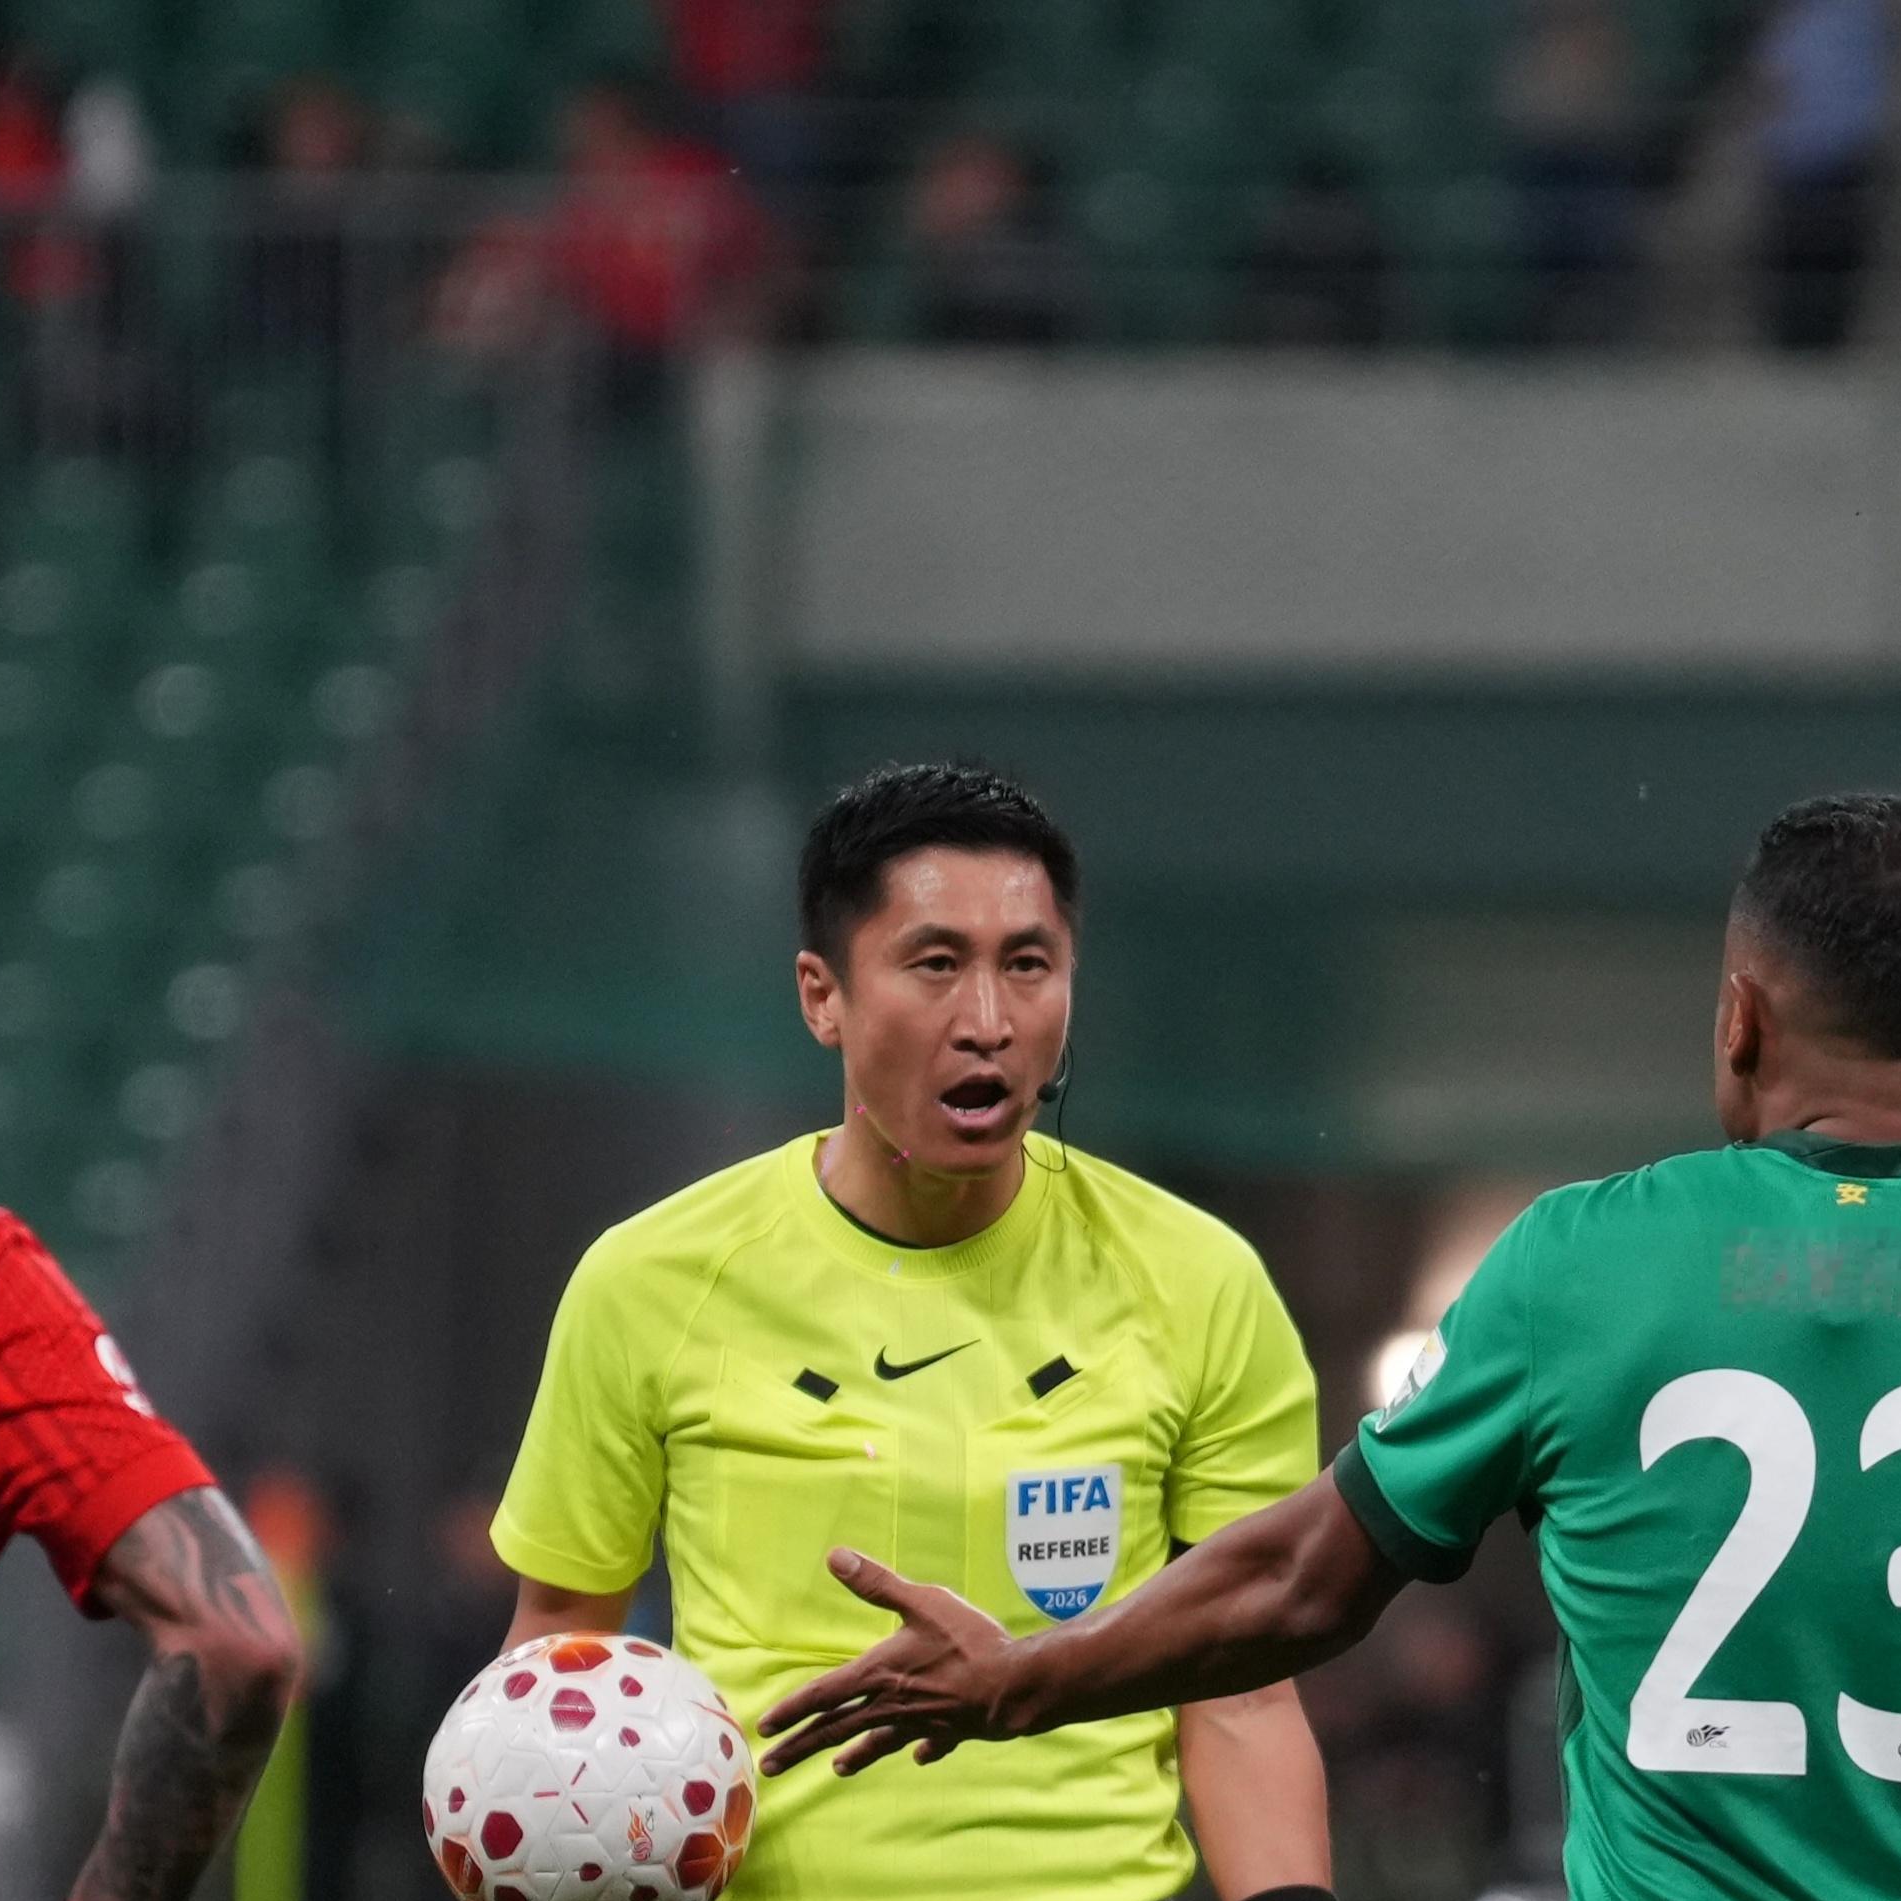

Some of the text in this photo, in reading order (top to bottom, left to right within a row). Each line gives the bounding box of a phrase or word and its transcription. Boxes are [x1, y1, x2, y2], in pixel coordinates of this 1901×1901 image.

[1018, 1475, 1110, 1516] FIFA
[1017, 1535, 1110, 1562] REFEREE
[1043, 1589, 1088, 1609] 2026
